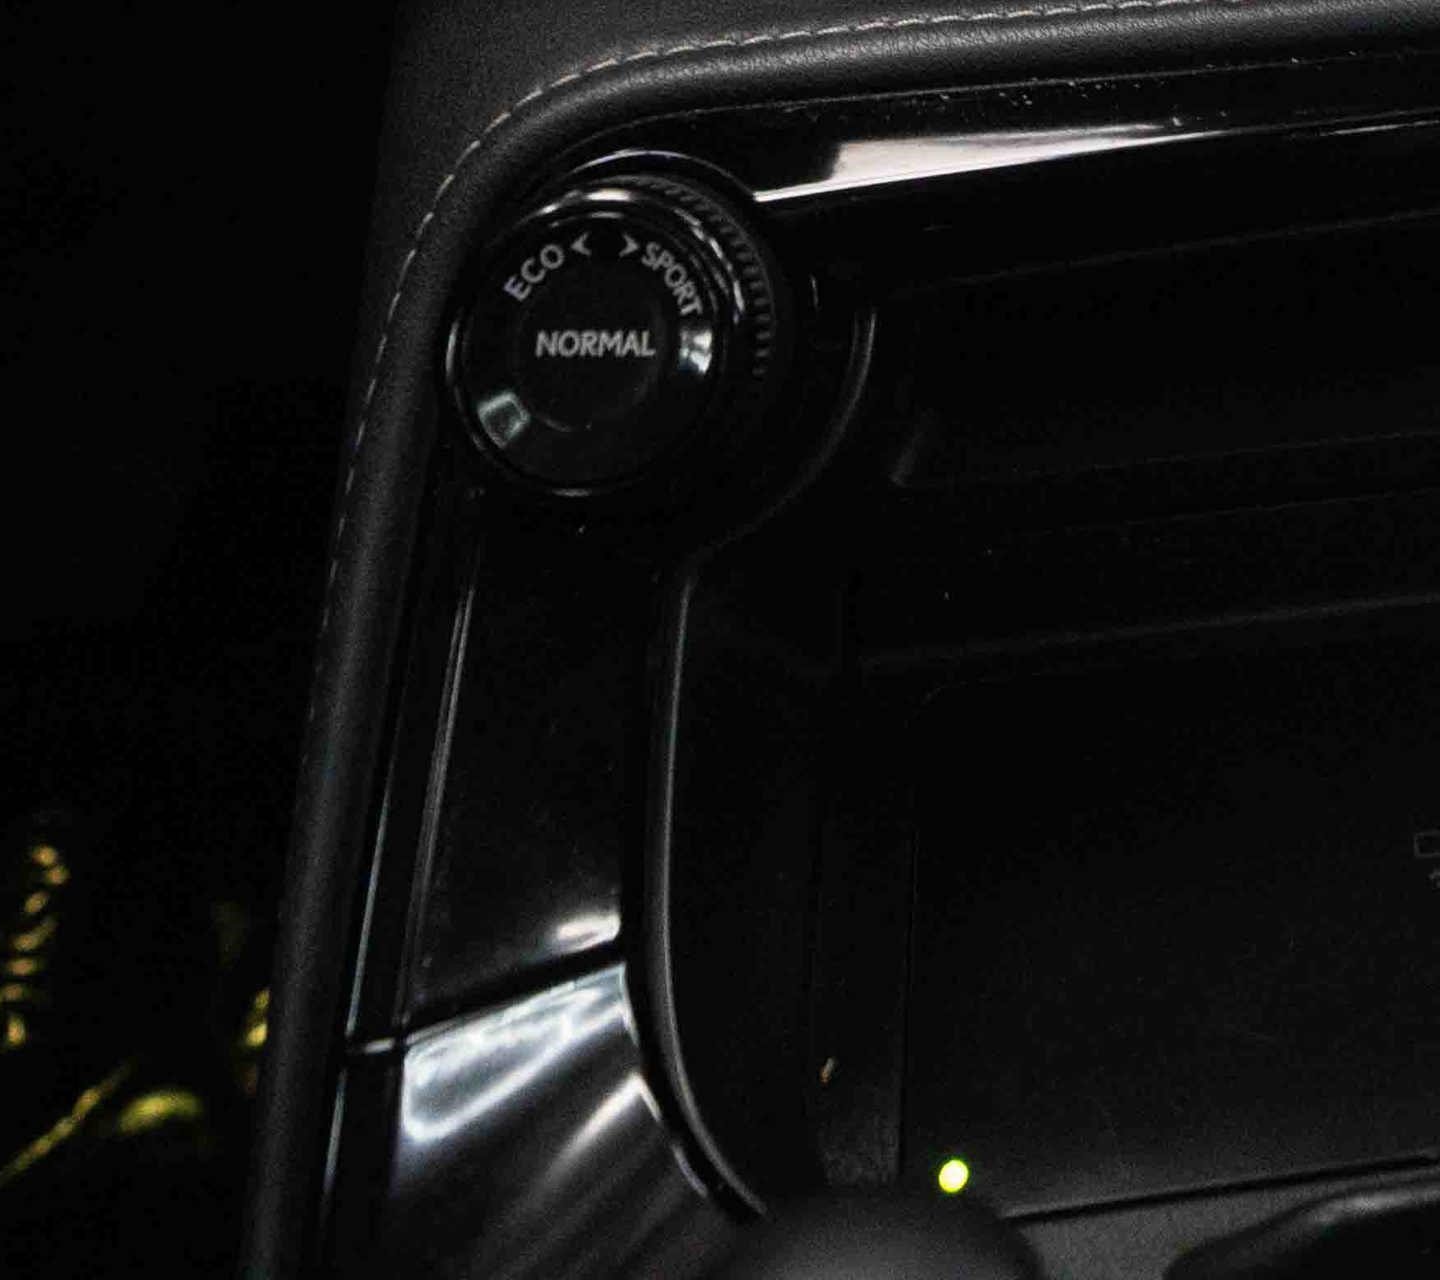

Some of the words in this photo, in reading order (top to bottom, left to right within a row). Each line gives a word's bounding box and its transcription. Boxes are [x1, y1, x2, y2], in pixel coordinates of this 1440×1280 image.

[503, 243, 564, 302] ECO
[641, 243, 703, 316] SPORT
[535, 330, 657, 358] NORMAL
